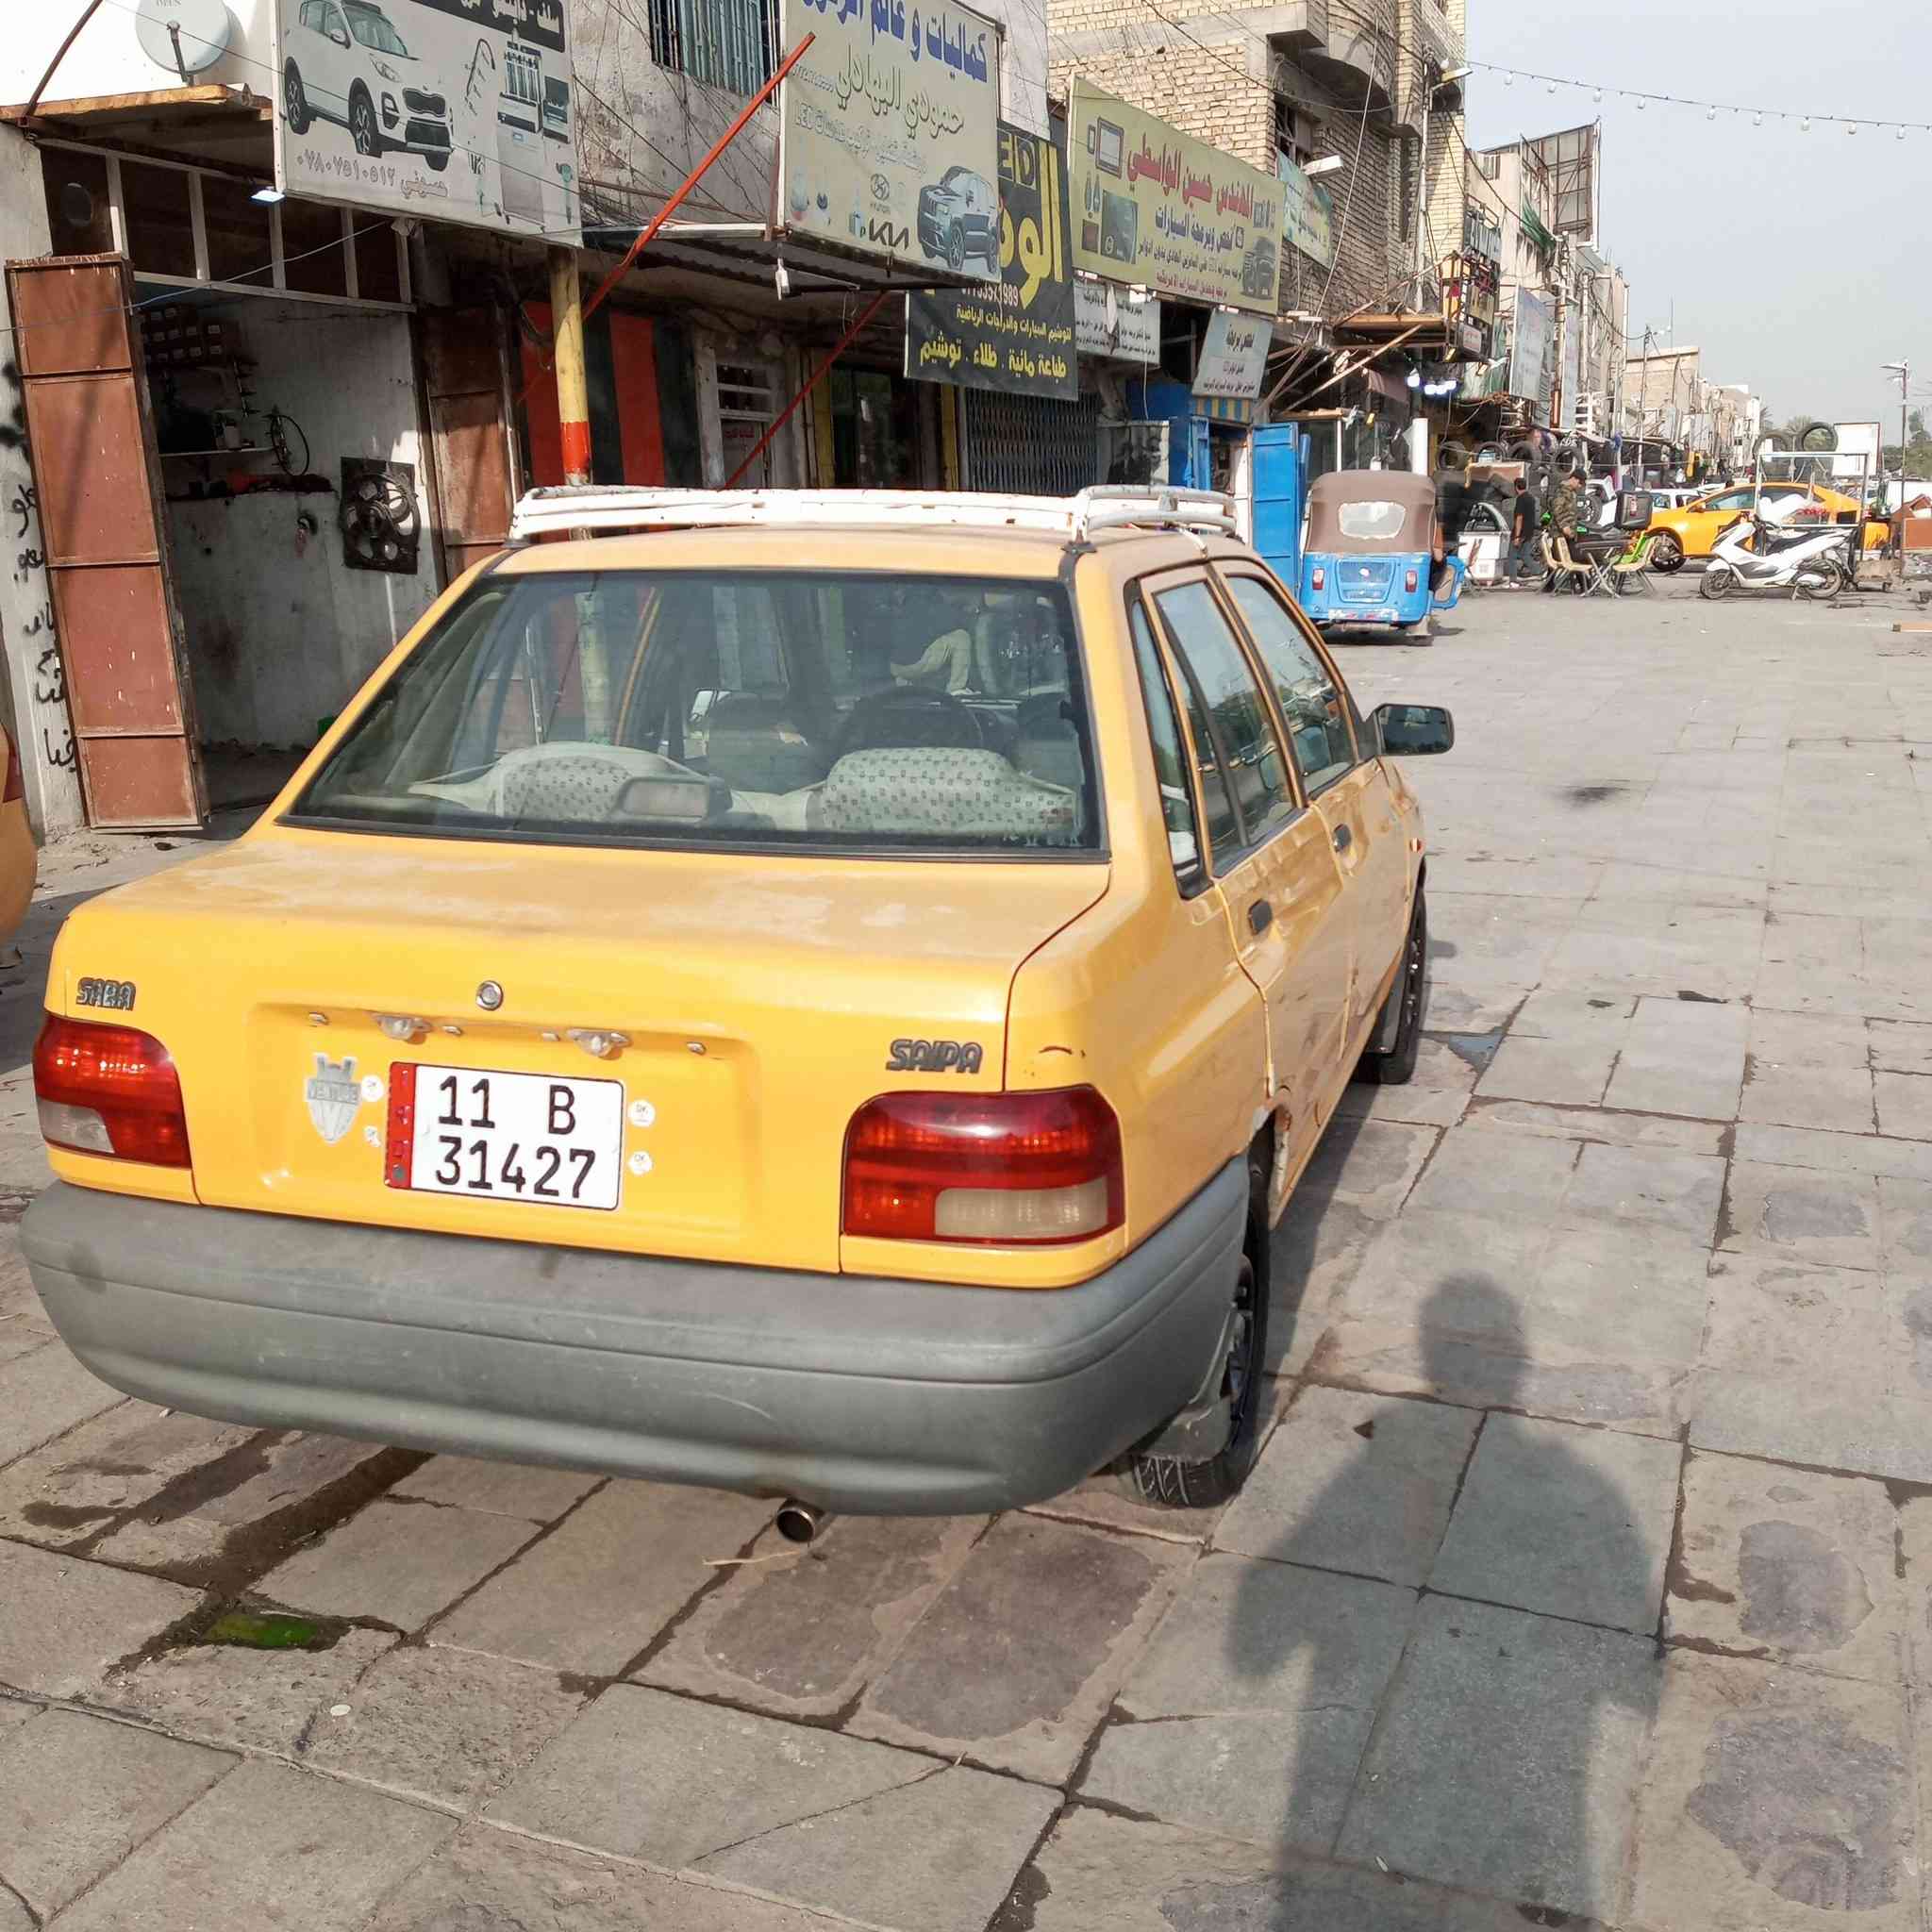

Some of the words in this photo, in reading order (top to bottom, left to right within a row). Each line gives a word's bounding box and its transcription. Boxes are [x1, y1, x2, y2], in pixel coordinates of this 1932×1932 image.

[910, 8, 921, 62] و
[925, 12, 988, 84] كماليات
[1182, 165, 1213, 209] حسين
[920, 330, 962, 369] توشيم
[1020, 319, 1047, 340] السيارات
[1038, 354, 1066, 385] طباعة
[75, 977, 137, 1012] SABA
[886, 1039, 984, 1074] SAIPA
[438, 1075, 496, 1129] 11
[547, 1084, 576, 1136] B
[435, 1135, 596, 1199] 31427
